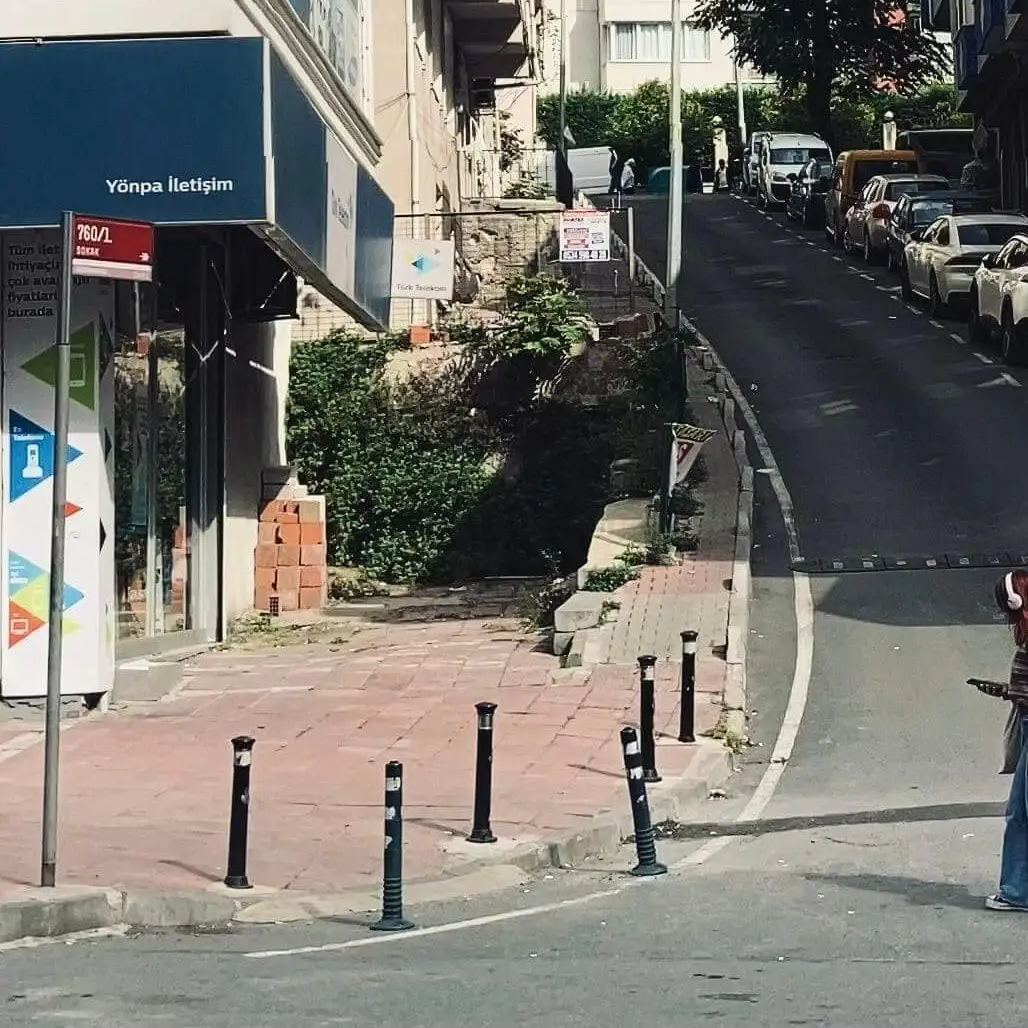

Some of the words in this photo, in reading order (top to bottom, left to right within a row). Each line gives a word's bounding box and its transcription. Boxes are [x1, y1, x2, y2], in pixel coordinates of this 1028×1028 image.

[105, 178, 163, 196] Yönpa
[168, 175, 233, 195] İletişim
[77, 223, 113, 244] 760/1
[8, 244, 34, 255] Tüm
[75, 245, 100, 257] SOKAK
[8, 306, 54, 317] burada
